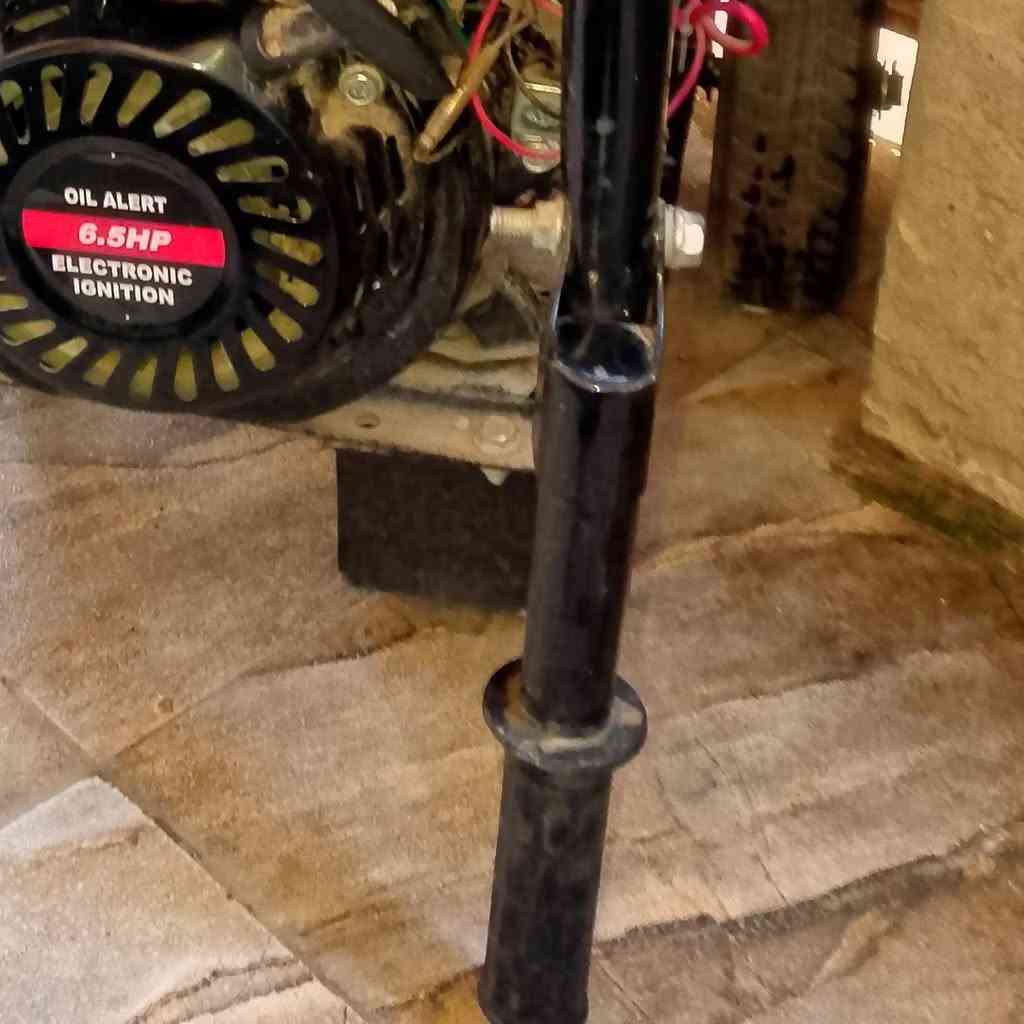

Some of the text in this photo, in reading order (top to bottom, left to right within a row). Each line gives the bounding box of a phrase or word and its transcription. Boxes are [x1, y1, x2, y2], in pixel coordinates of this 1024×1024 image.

[64, 186, 167, 213] OIL ALERT
[78, 222, 172, 251] 6.5HP
[51, 254, 192, 286] ELECTRONIC
[74, 278, 174, 305] IGNITION
